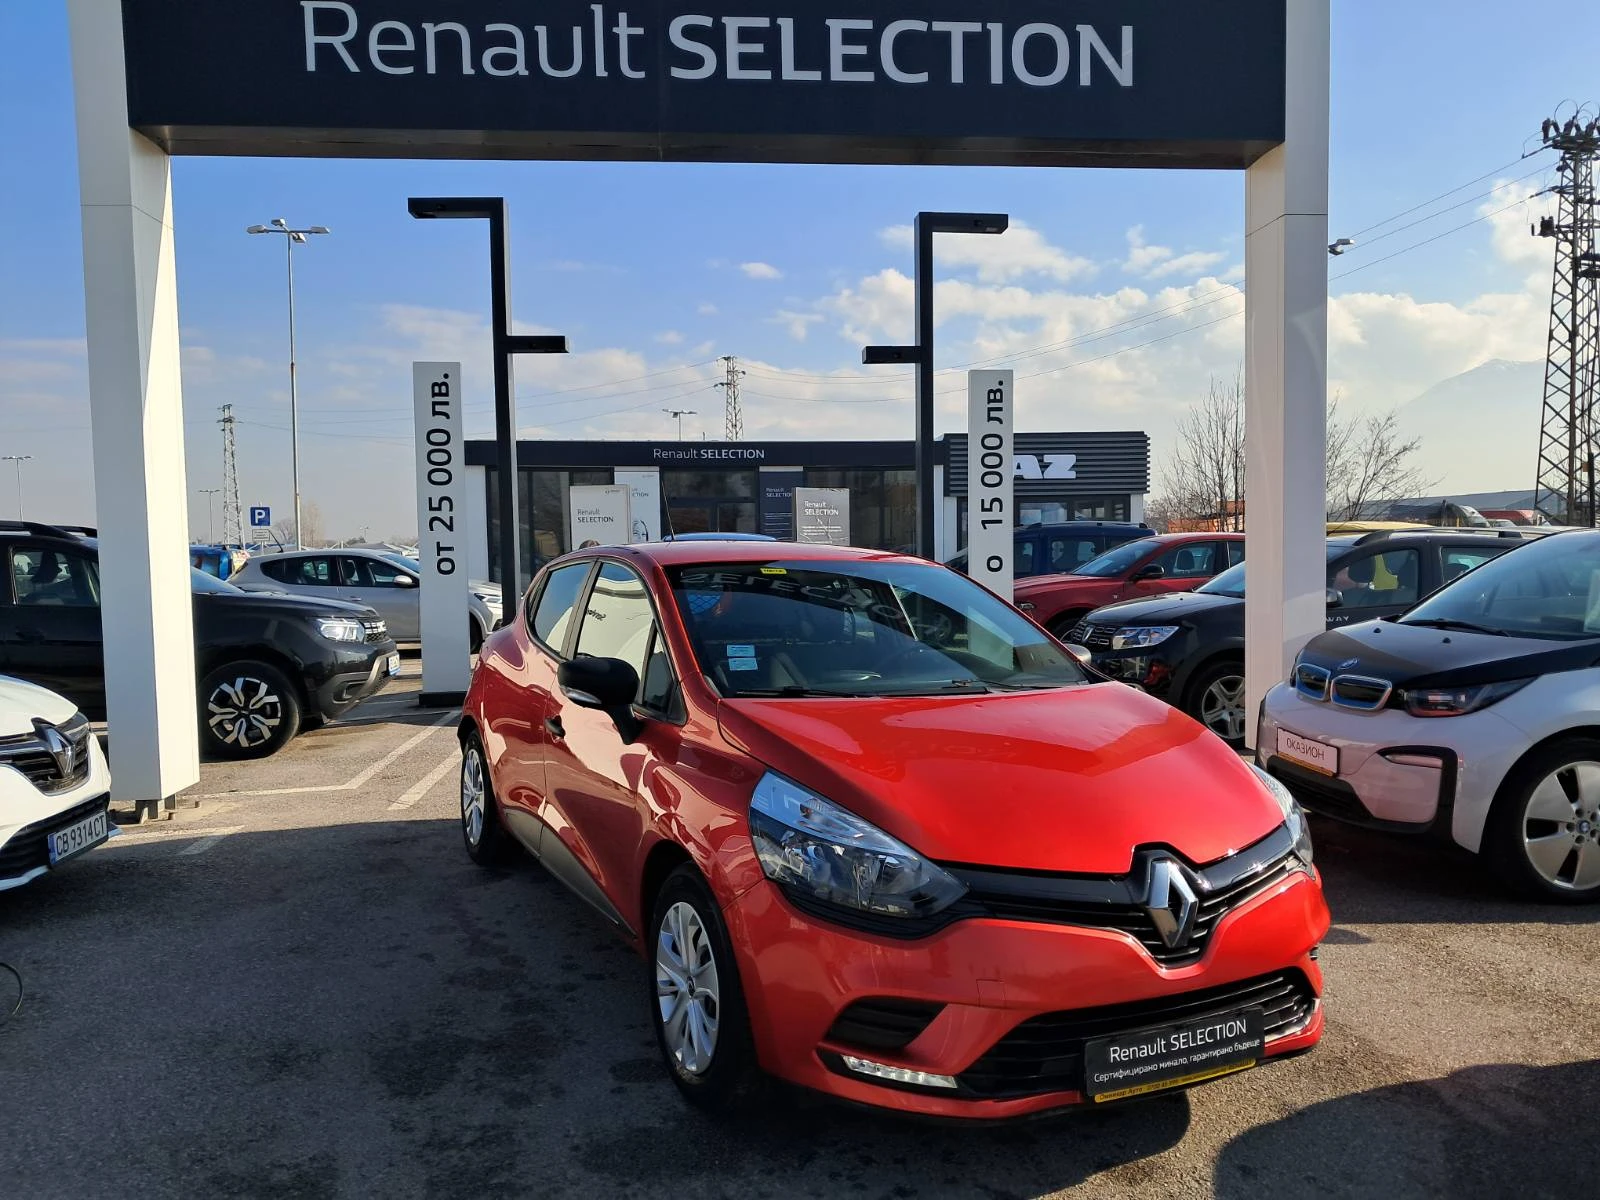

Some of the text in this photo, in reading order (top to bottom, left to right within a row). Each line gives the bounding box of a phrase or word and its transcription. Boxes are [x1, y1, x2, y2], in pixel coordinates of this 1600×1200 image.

[300, 1, 1133, 87] Renault SELECTION
[986, 380, 1004, 425] лв.
[653, 448, 765, 460] Renault SELECTION
[980, 433, 1004, 488] 000
[1013, 454, 1077, 479] AZ
[426, 372, 456, 575] от 25 000 лв.
[254, 509, 266, 524] P
[576, 516, 614, 524] SELECTION
[804, 508, 839, 517] SELECTION
[980, 497, 1004, 530] 15
[1109, 1018, 1247, 1064] Renault SELECTION
[1094, 1063, 1158, 1083] Сертифицирано
[1189, 1045, 1233, 1063] гарантирано
